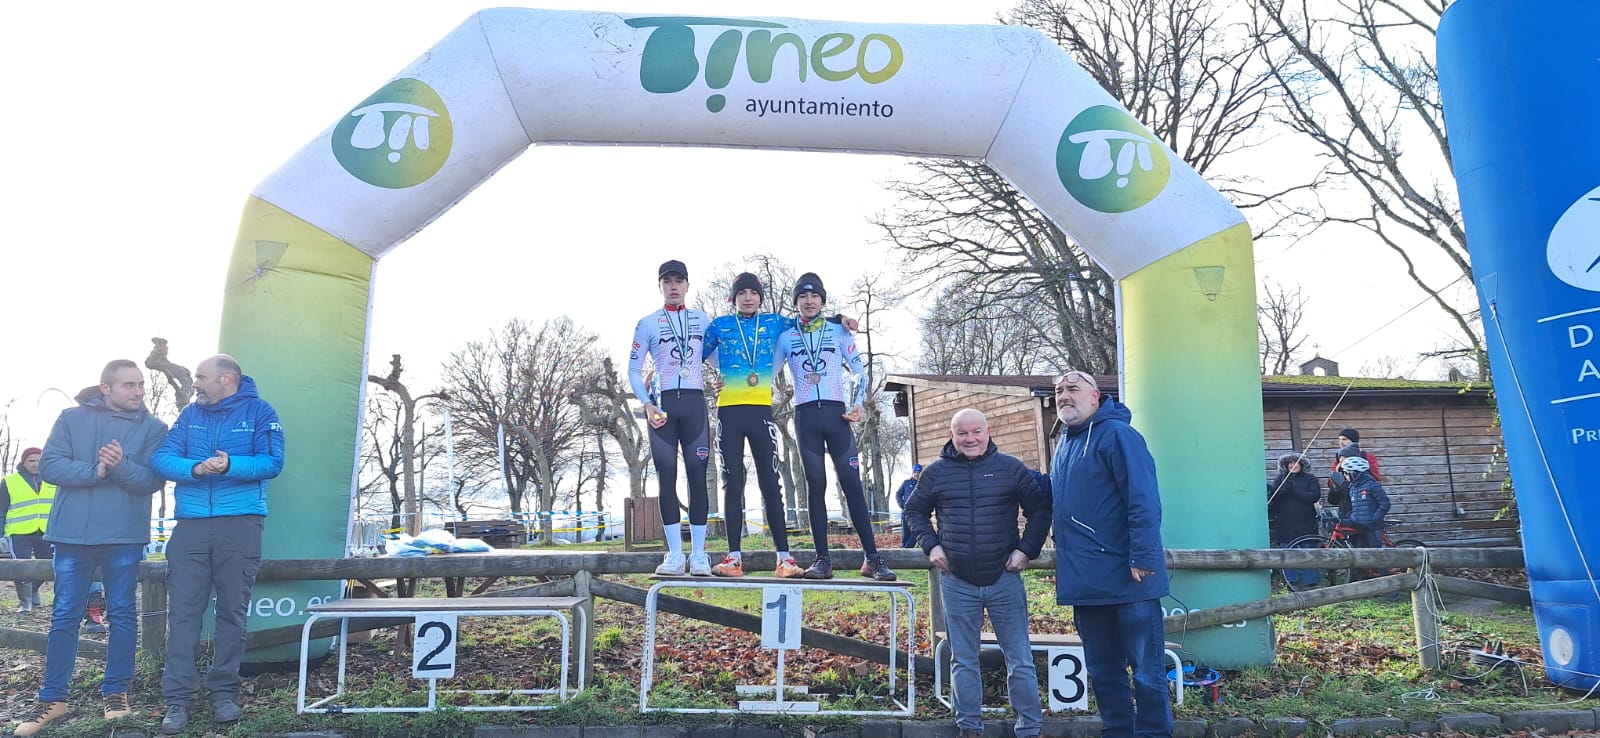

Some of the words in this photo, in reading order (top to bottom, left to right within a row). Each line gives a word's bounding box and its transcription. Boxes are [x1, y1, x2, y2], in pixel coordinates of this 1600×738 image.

[624, 16, 904, 113] Tineo
[745, 96, 894, 119] ayuntamiento
[766, 593, 787, 644] 1
[416, 621, 452, 671] 2
[1051, 653, 1085, 703] 3
